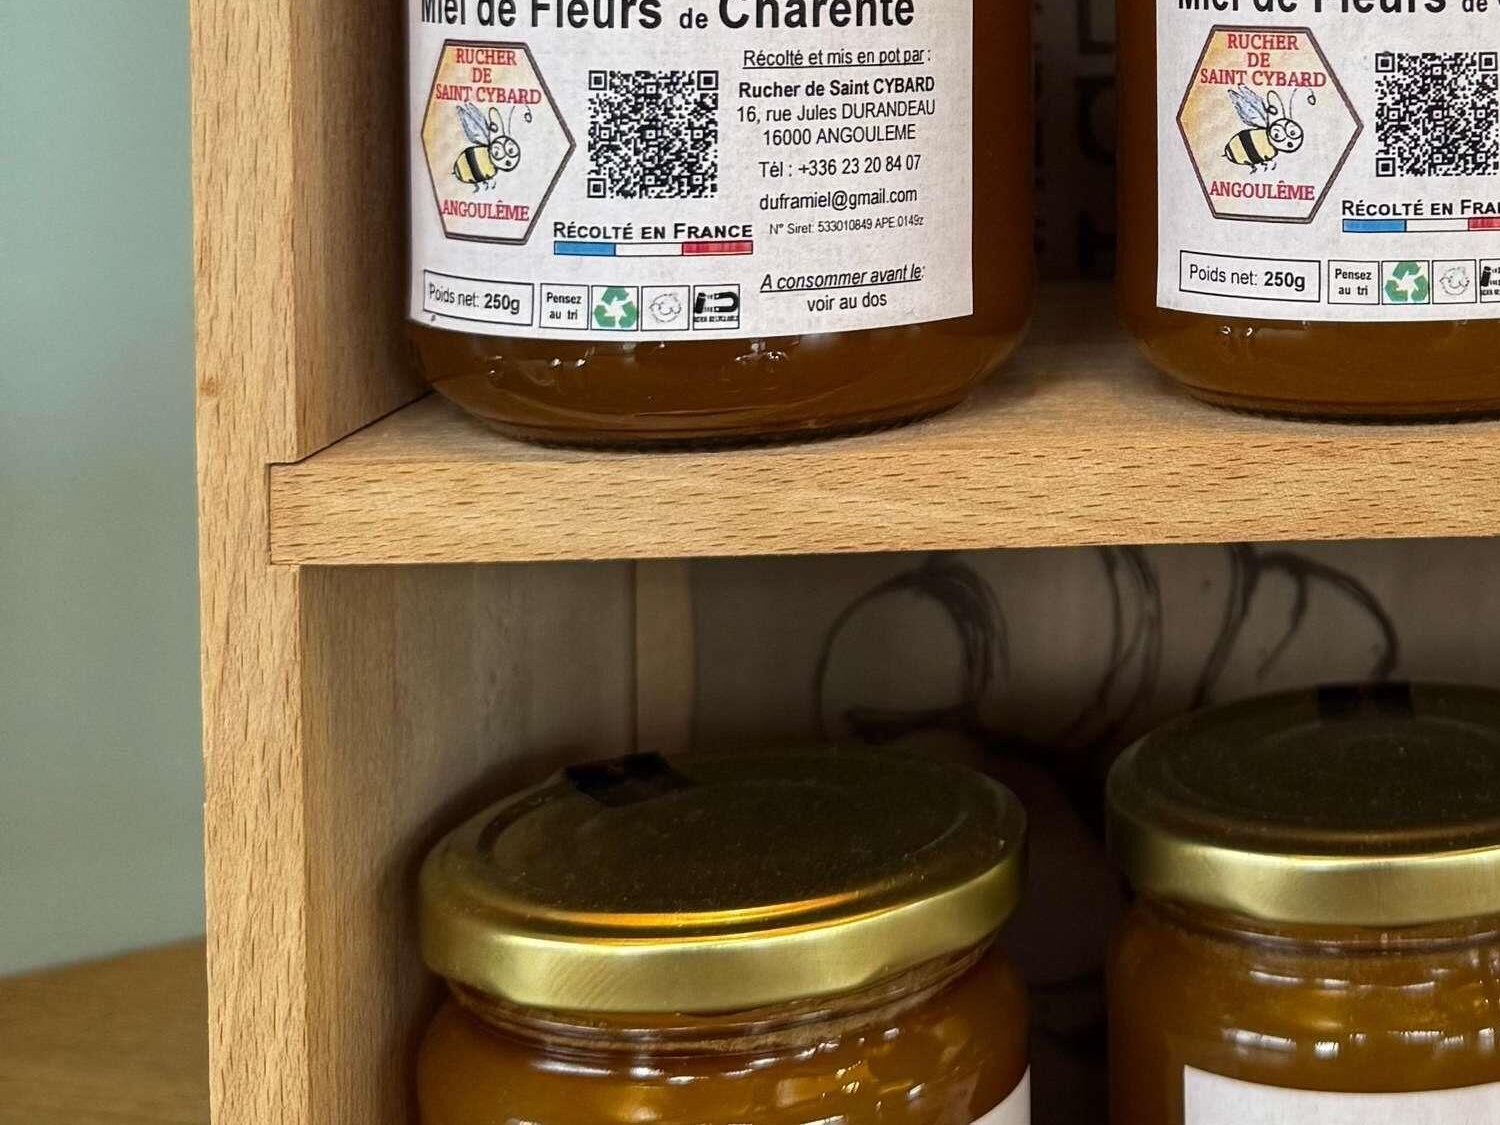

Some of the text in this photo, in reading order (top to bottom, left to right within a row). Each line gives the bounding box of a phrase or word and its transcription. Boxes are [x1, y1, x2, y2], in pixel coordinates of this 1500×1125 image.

[679, 7, 708, 29] de
[1227, 34, 1299, 50] RUCHER
[456, 49, 517, 65] RUCHER
[743, 49, 803, 66] Récolté
[808, 50, 823, 65] et
[827, 49, 853, 64] mis
[857, 51, 875, 64] en
[879, 49, 900, 65] pot
[1247, 52, 1270, 68] DE
[472, 68, 492, 84] DE
[1200, 68, 1327, 87] SAINT CYBARD
[436, 84, 542, 104] SAINT CYBARD
[739, 76, 935, 98] Rucher de Saint CYBARD
[737, 99, 935, 124] 16, rue Jules DURANDEAU
[764, 124, 916, 146] 16000 ANGOULEME
[759, 154, 921, 178] Tél +336 23 20 84 07
[759, 189, 917, 211] duframiel@gmail.com
[1209, 180, 1315, 202] ANGOULÊME
[439, 199, 530, 222] ANGOULÊME
[1341, 199, 1424, 216] RÉCOLTÉ
[553, 221, 634, 240] RÉCOLTÉ
[673, 223, 753, 239] FRANCE
[818, 218, 872, 233] 533010849
[760, 274, 772, 290] A
[777, 270, 867, 289] consommer
[870, 266, 908, 283] avant
[1189, 264, 1306, 291] Poids net: 250g
[1335, 268, 1372, 281] Pensez
[429, 283, 520, 314] Poids net: 250g
[546, 292, 582, 305] Pensez
[1338, 284, 1368, 296] au tri
[807, 292, 887, 312] voir au dos
[550, 309, 578, 320] au tri
